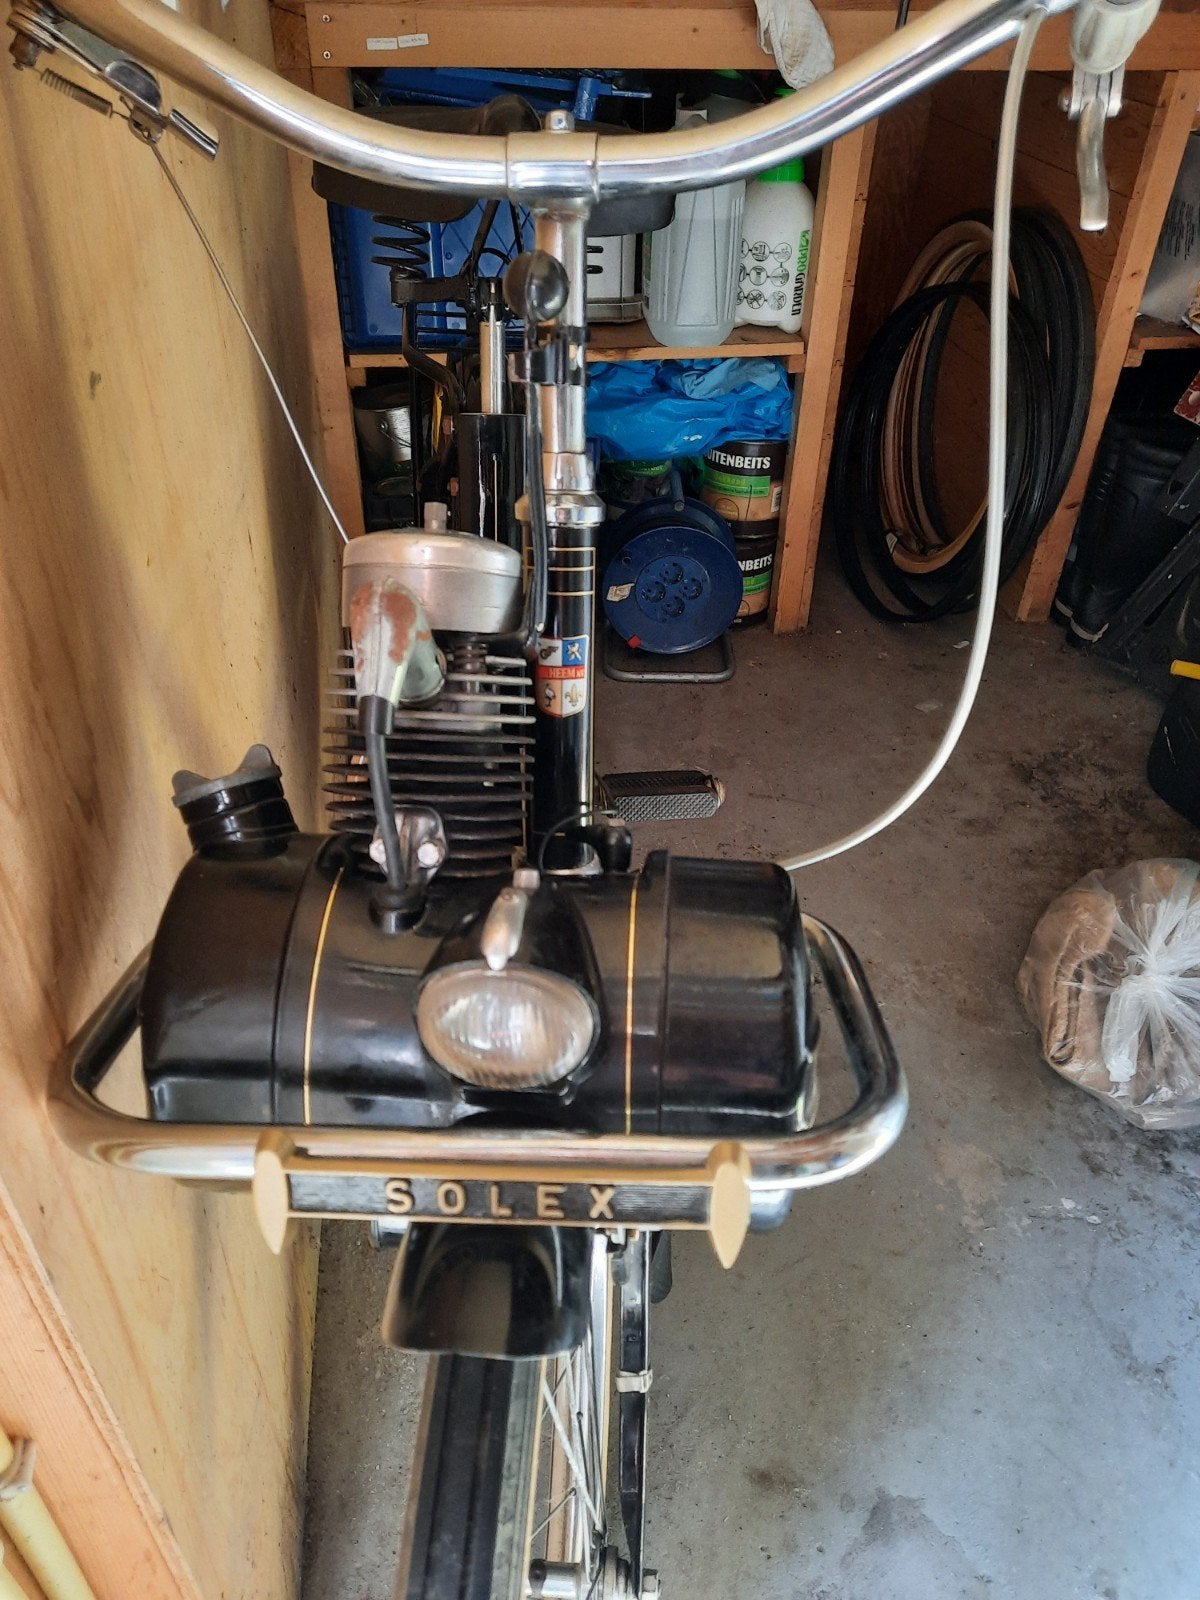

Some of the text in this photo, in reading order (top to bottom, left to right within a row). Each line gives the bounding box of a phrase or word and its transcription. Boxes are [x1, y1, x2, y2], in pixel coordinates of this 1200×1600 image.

[706, 448, 771, 470] UITENBEITS
[738, 553, 772, 571] NBEITS
[385, 1178, 615, 1220] SOLEX
